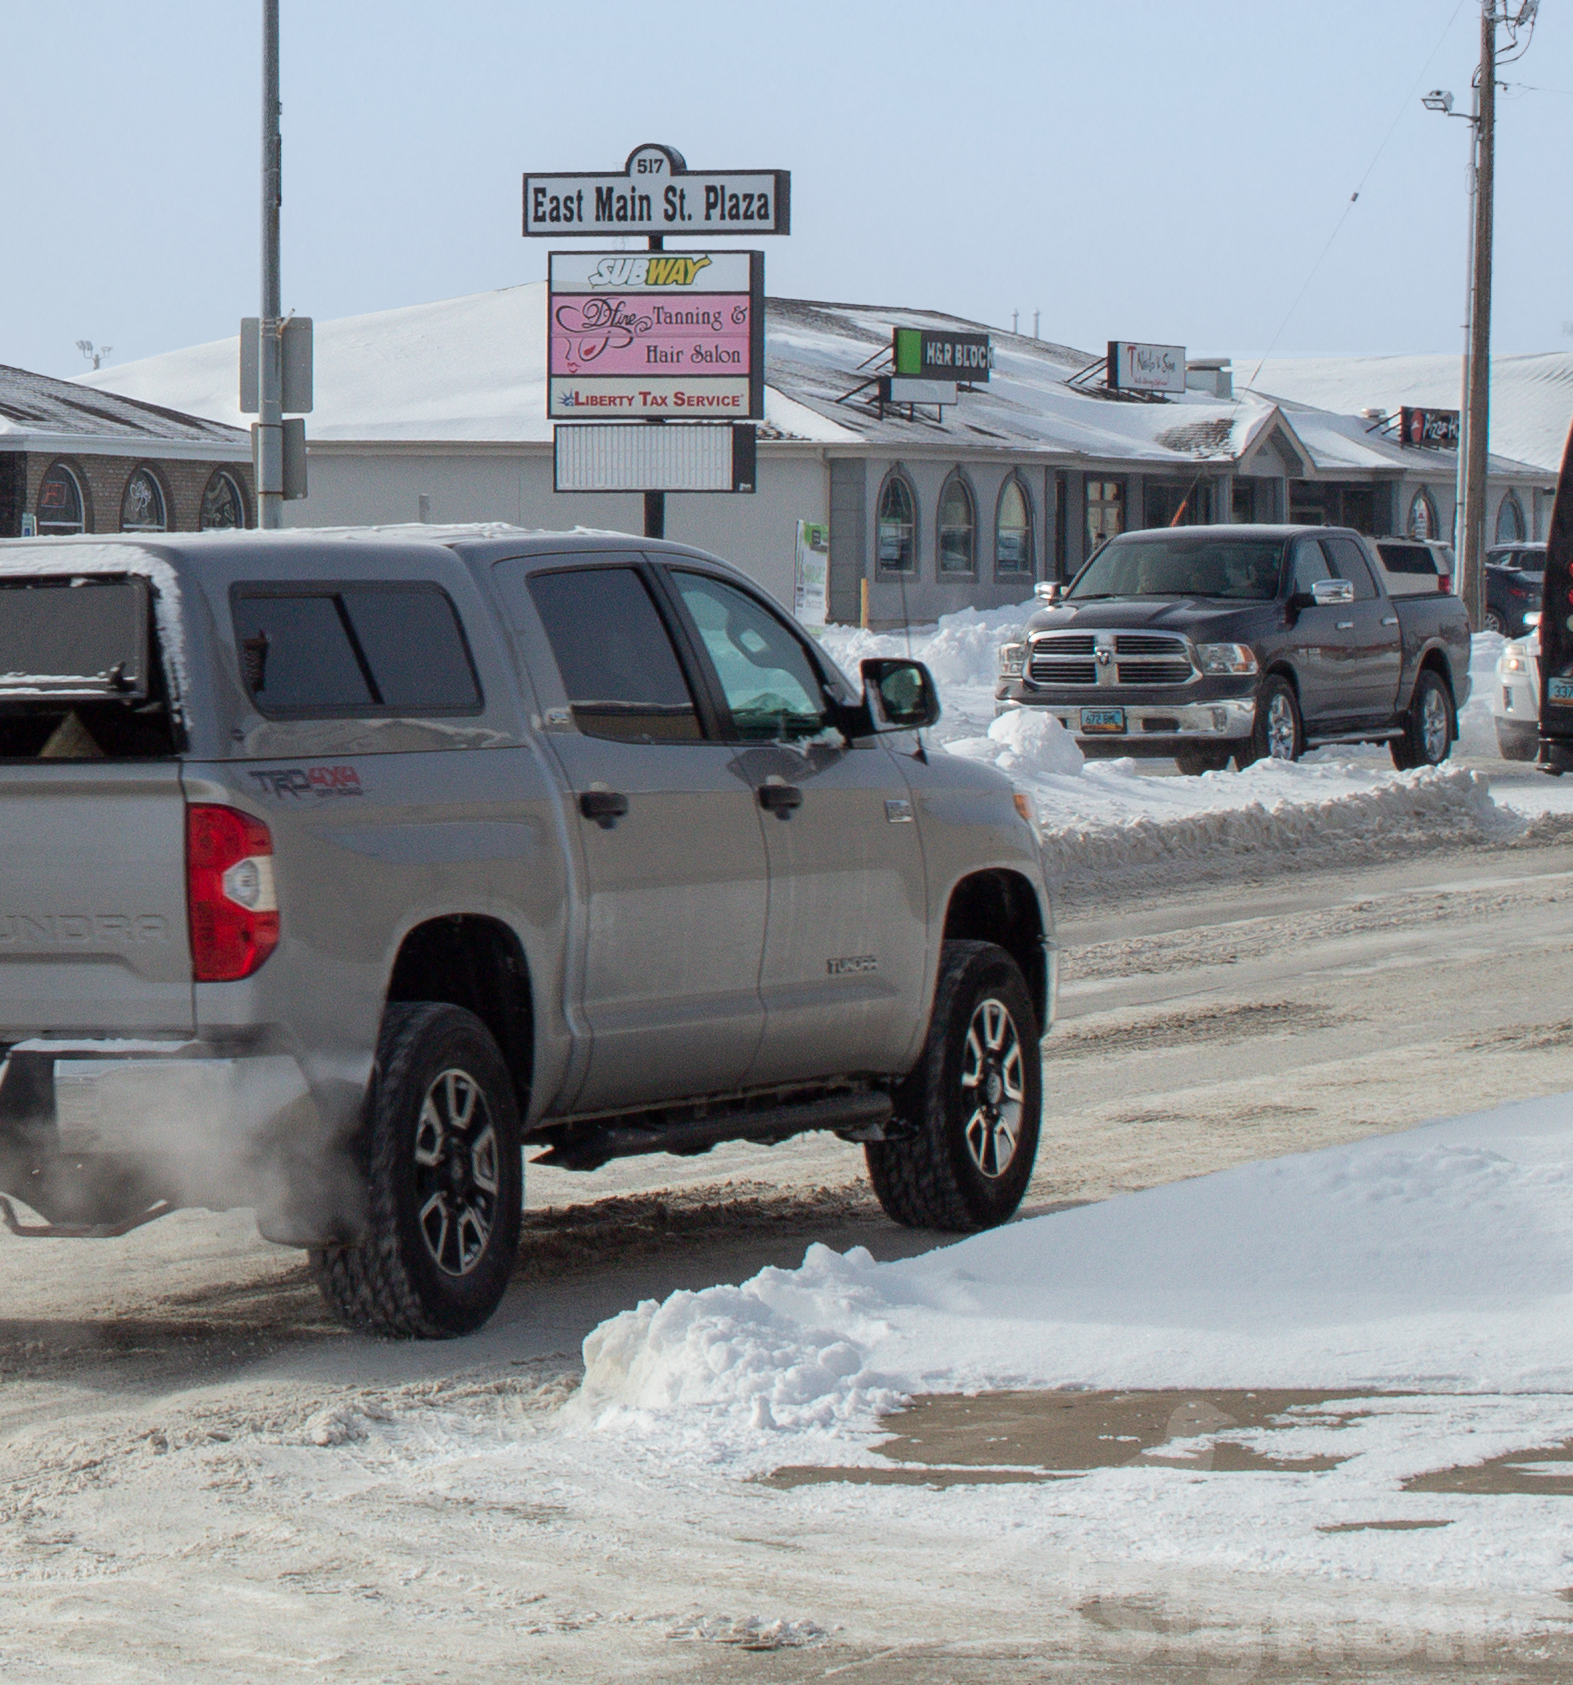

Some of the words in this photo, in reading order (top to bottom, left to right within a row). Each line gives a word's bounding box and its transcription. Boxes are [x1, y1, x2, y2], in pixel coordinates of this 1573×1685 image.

[637, 159, 664, 175] 517
[533, 187, 583, 222] East
[595, 186, 651, 222] Main
[663, 185, 692, 221] St.
[705, 184, 769, 221] Plaza
[588, 254, 712, 289] SUBWAY
[653, 306, 722, 331] Tanning
[731, 305, 748, 324] &
[645, 345, 683, 363] Hair
[690, 344, 741, 363] Salon
[926, 342, 952, 366] H&R
[955, 344, 994, 369] BLOCK
[248, 769, 312, 800] TRD
